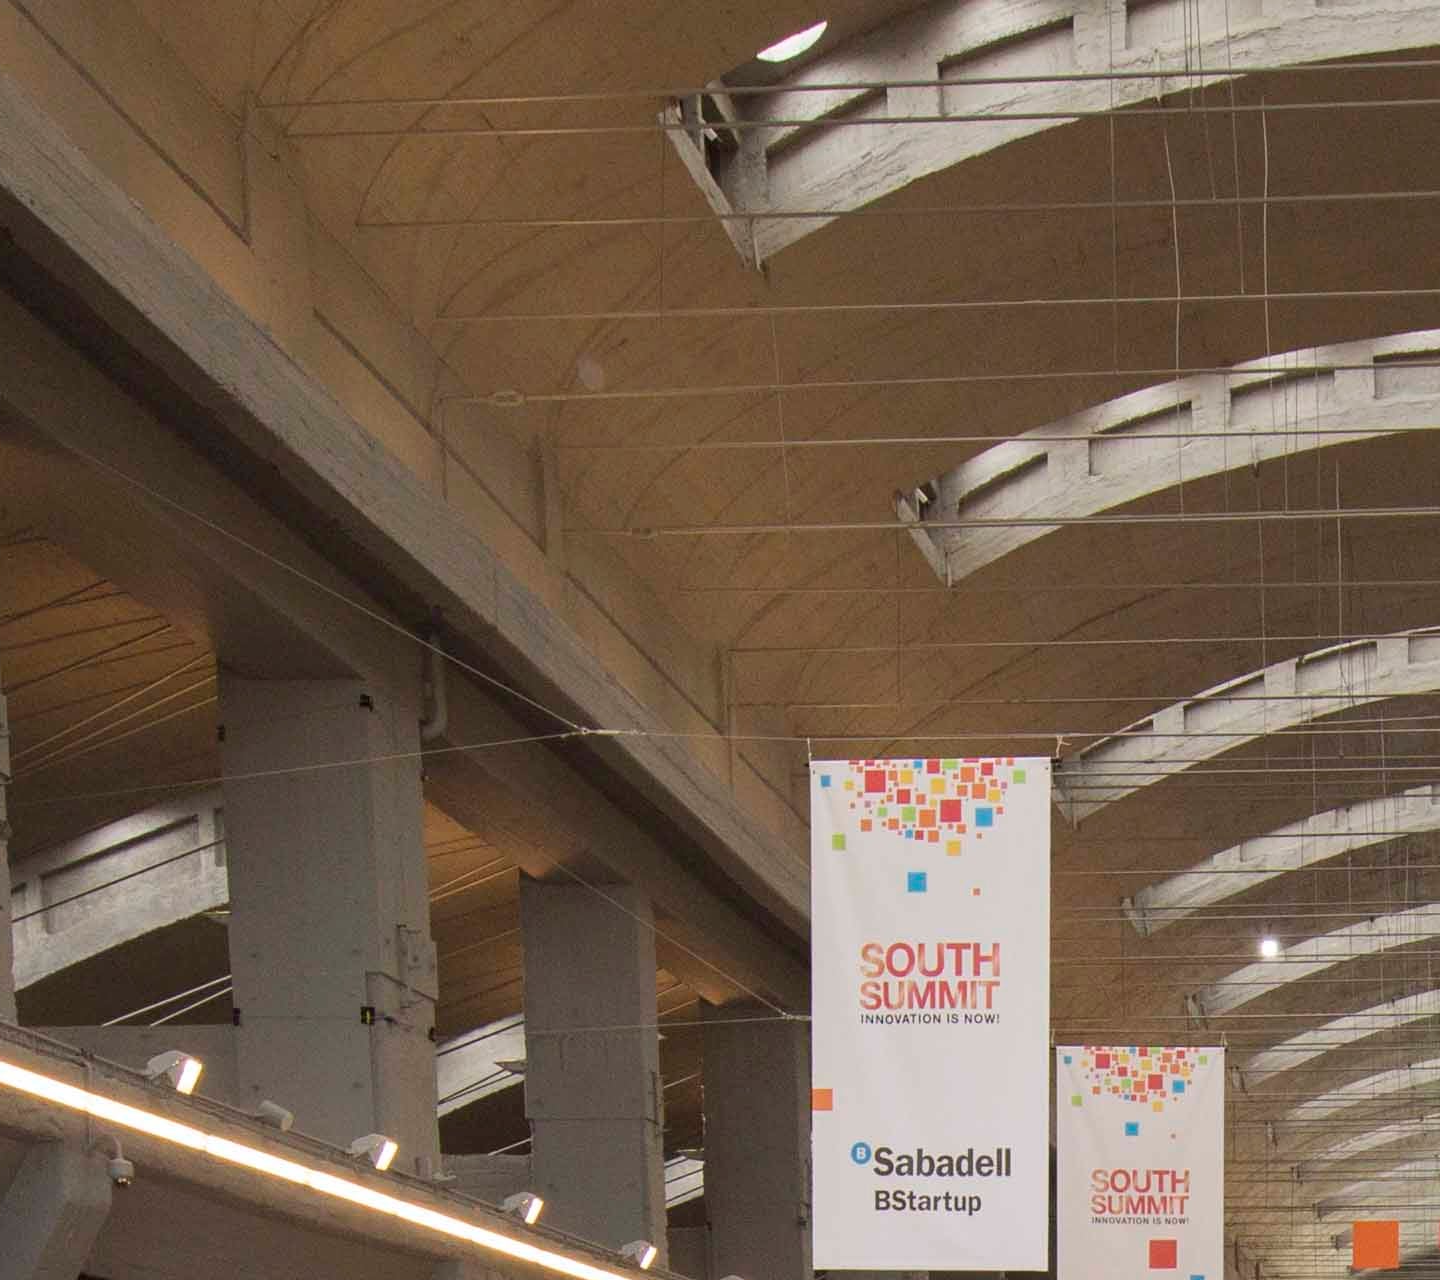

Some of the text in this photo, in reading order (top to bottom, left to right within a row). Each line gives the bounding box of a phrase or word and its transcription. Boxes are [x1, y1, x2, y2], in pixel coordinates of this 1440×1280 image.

[860, 943, 1000, 978] SOUTH
[860, 980, 1000, 1010] SUMMIT
[861, 1014, 1000, 1025] INNOVATION IS NOW!
[873, 1146, 1012, 1177] Sabadell
[1091, 1169, 1189, 1193] SOUTH
[874, 1189, 982, 1216] BStartup
[1091, 1195, 1189, 1215] SUMMIT
